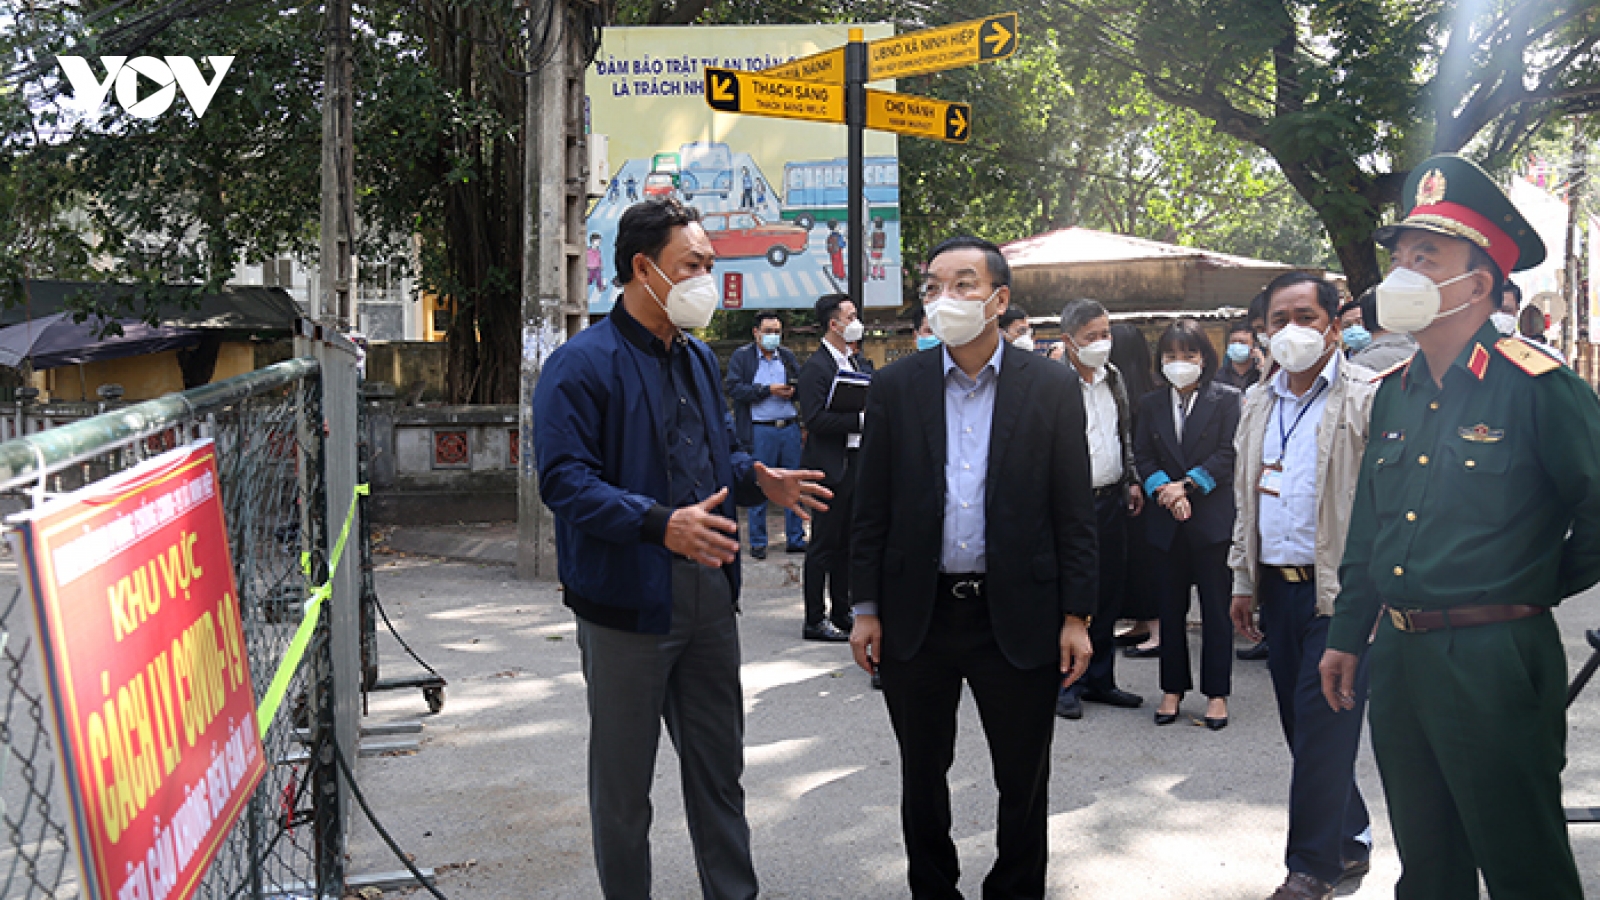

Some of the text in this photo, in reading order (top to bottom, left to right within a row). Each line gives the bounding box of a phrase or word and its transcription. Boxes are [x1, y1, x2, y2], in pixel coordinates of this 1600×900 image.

[612, 76, 631, 96] LÀ
[633, 76, 682, 96] TRÁCH
[632, 53, 664, 75] BẢO
[106, 558, 162, 643] KHU
[157, 530, 203, 601] VỰC
[87, 670, 163, 845] CÁCH
[146, 650, 182, 777] LY
[172, 592, 244, 748] COVID-19
